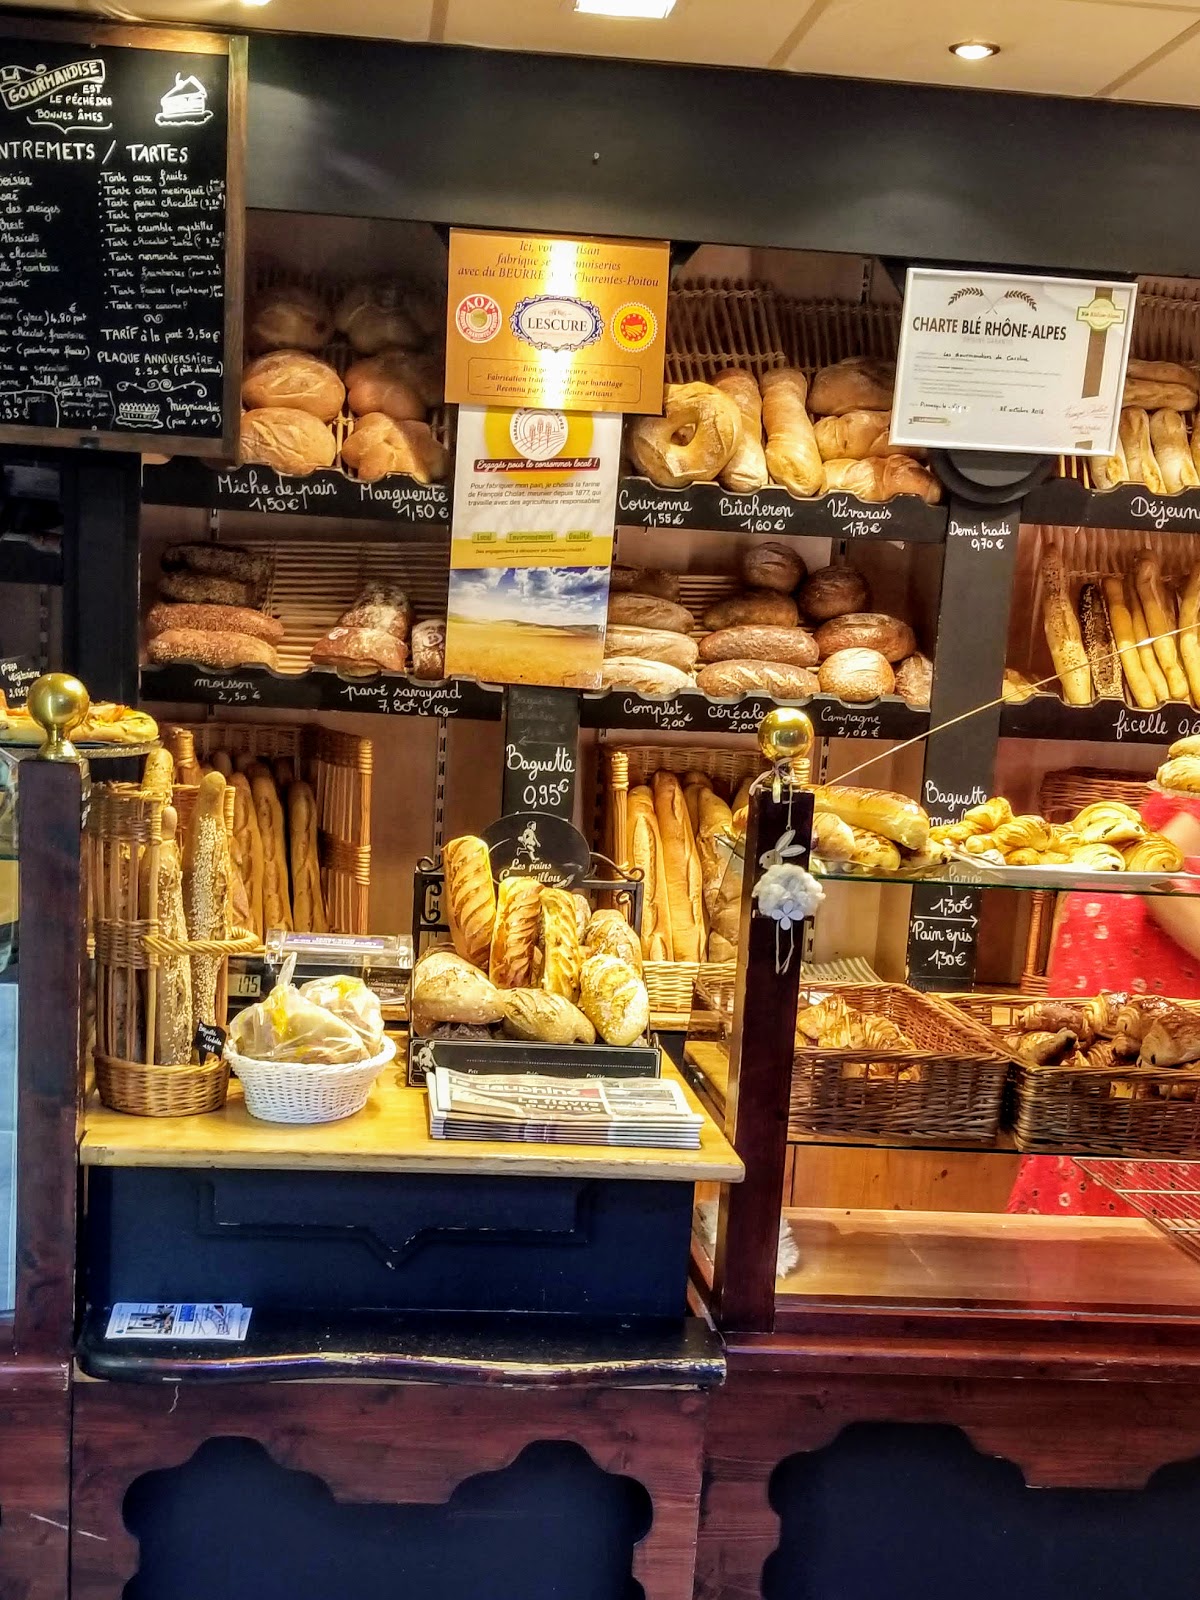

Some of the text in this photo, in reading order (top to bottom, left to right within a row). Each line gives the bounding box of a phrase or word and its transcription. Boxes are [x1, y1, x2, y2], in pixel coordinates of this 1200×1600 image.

[2, 68, 21, 81] LA
[9, 61, 100, 103] GOURMANDISE
[83, 84, 103, 95] EST
[50, 96, 61, 105] LE
[36, 108, 104, 122] BONNES ÂMES
[0, 142, 189, 163] NTREMETS TARTES
[133, 175, 153, 183] aux
[159, 169, 188, 187] fruits
[496, 253, 538, 267] fabrique
[458, 267, 480, 277] avec
[482, 267, 496, 277] du
[527, 317, 588, 332] LESCURE
[912, 315, 1067, 341] CHARTE BLÉ RHÔNE-ALPES
[97, 351, 215, 365] PLAQUE ANNIVERSAIRE
[506, 461, 525, 471] pour
[534, 460, 571, 469] consommer
[571, 459, 591, 468] local
[217, 470, 337, 509] Miche de pain
[470, 482, 485, 490] Pour
[486, 482, 514, 490] fabriquer
[360, 483, 448, 509] Marguerite
[522, 499, 558, 507] agriculteurs
[619, 490, 693, 512] Couronne
[827, 498, 892, 520] Vivarais
[1130, 496, 1200, 529] Déjeun
[949, 521, 1012, 536] Demi tradi
[194, 678, 257, 690] moisson
[393, 680, 462, 708] savoyard
[622, 698, 683, 722] Complet
[820, 708, 880, 730] Campagne
[1112, 710, 1169, 739] ficelle
[506, 743, 575, 781] Baguette
[925, 780, 987, 812] Baguette
[510, 858, 552, 873] Les pains
[912, 919, 973, 952] Pain épis
